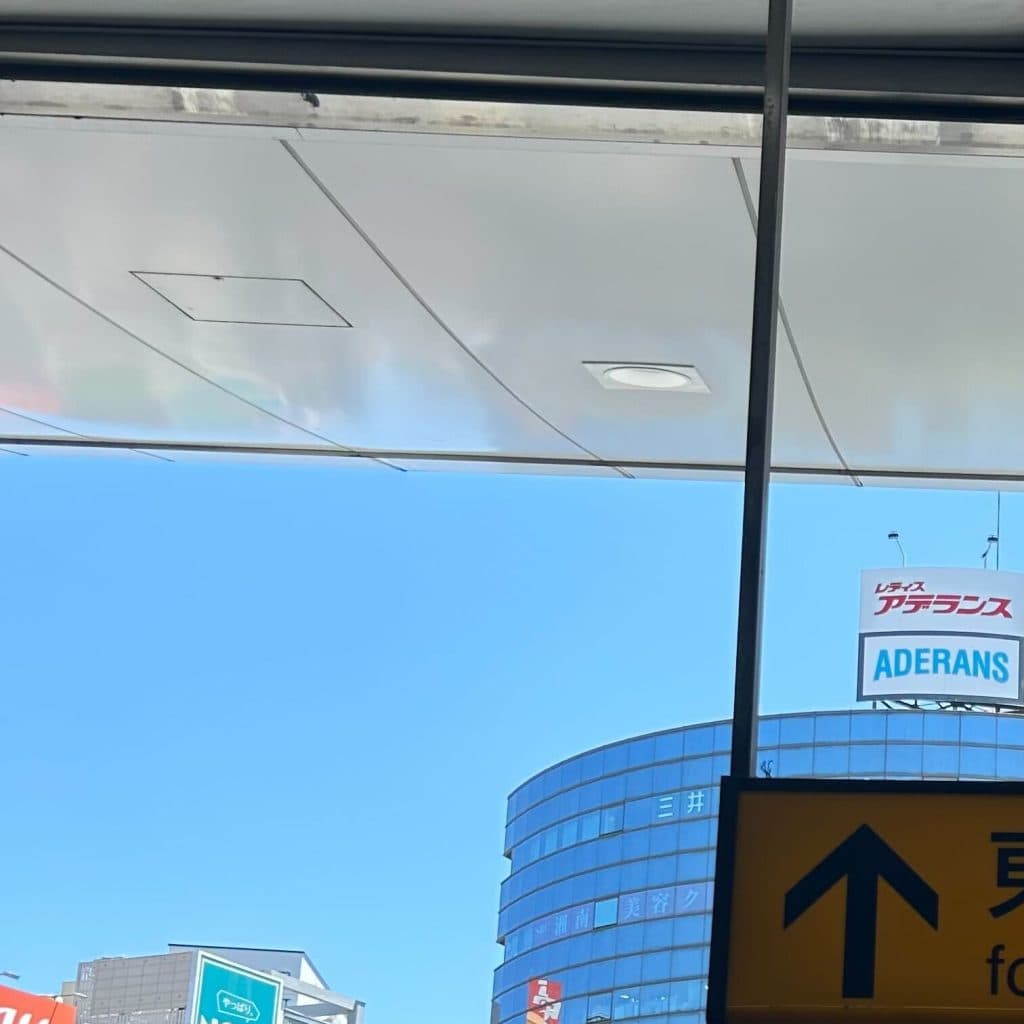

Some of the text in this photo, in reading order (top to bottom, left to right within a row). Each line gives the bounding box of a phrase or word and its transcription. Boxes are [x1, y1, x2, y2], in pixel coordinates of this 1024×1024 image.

[873, 594, 1013, 619] アデランス
[873, 648, 1009, 684] ADERANS
